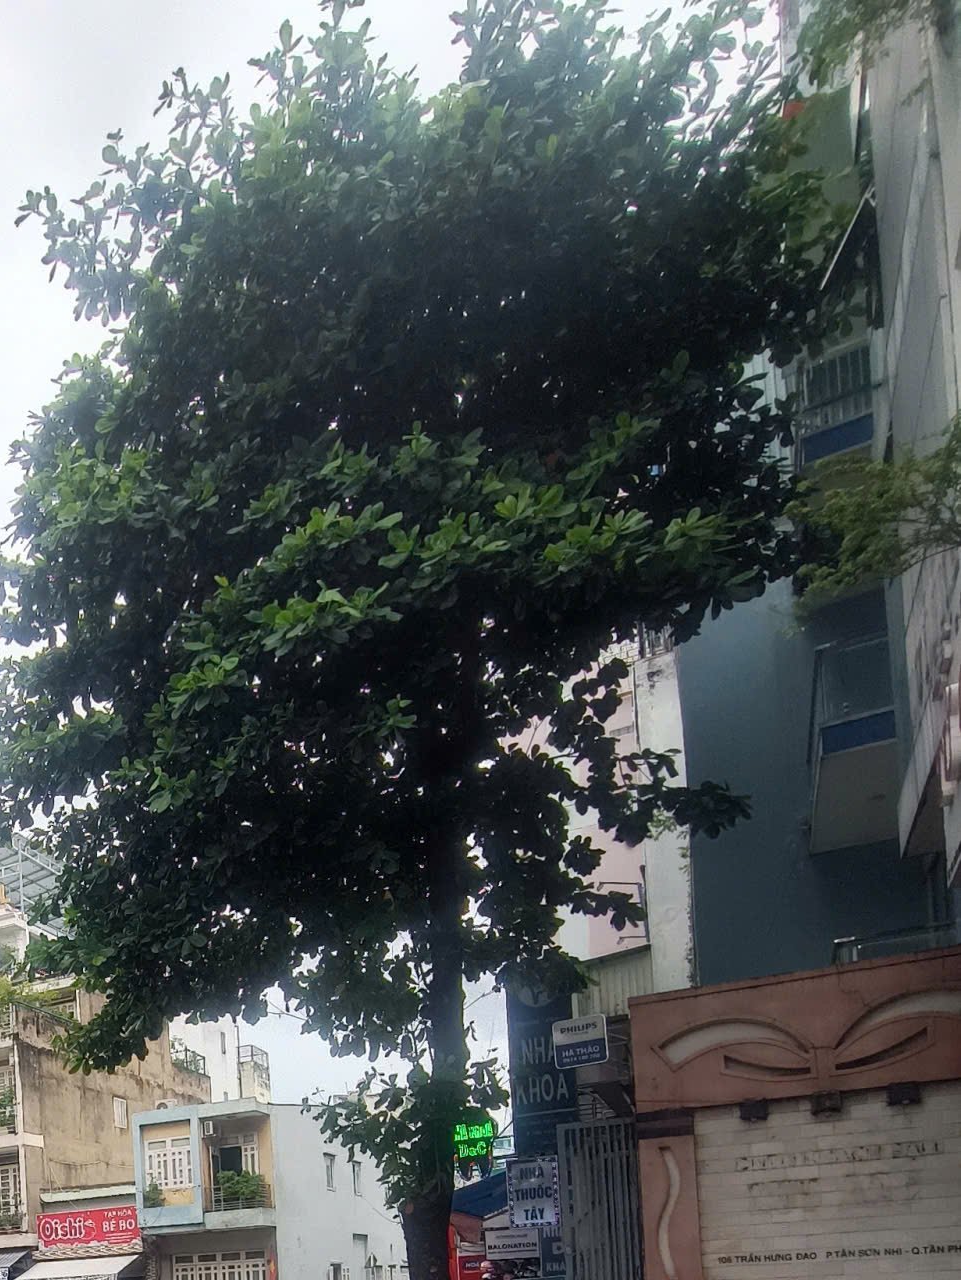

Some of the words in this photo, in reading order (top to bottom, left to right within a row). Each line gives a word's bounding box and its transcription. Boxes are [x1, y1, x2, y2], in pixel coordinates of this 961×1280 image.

[560, 1021, 598, 1034] PHILIPS
[516, 1073, 569, 1105] KHOA
[519, 1163, 544, 1180] NHÀ
[514, 1182, 553, 1202] THUỐC
[523, 1206, 545, 1221] TÂY
[40, 1217, 85, 1241] Oishi
